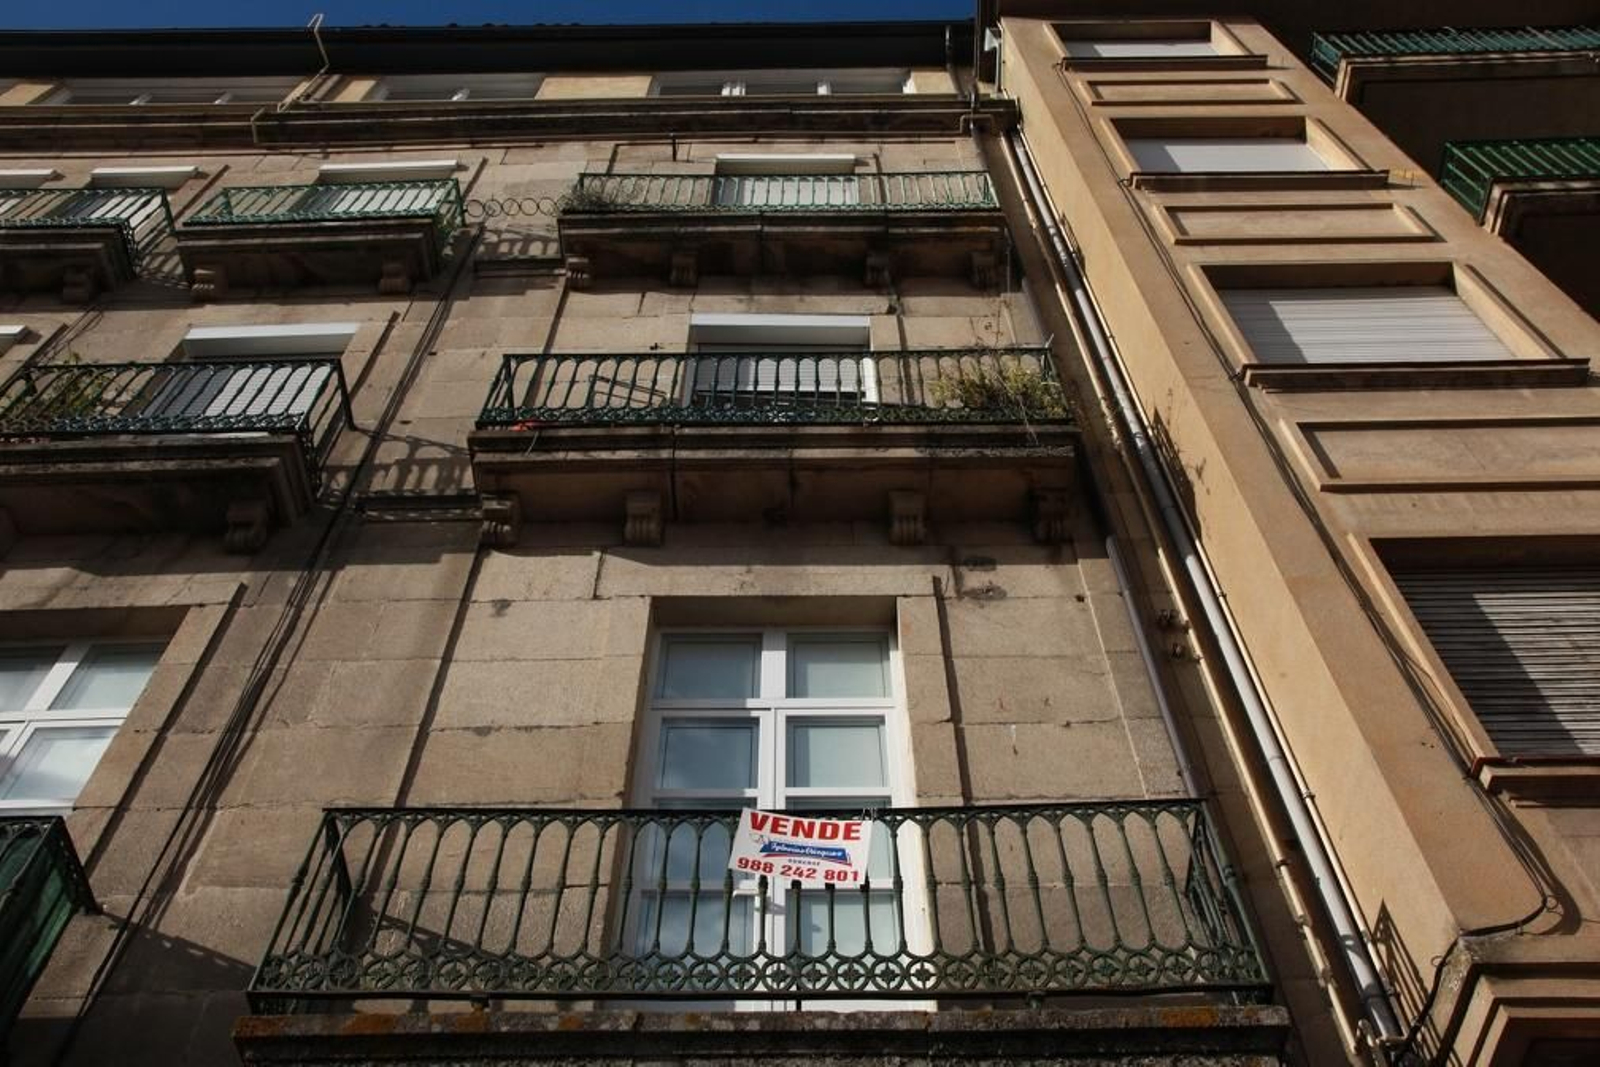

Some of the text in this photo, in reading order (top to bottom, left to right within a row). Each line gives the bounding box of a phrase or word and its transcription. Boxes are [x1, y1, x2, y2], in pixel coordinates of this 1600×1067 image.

[750, 812, 862, 840] VENDE
[737, 857, 774, 874] 988
[780, 864, 817, 879] 242
[824, 870, 859, 882] 801
